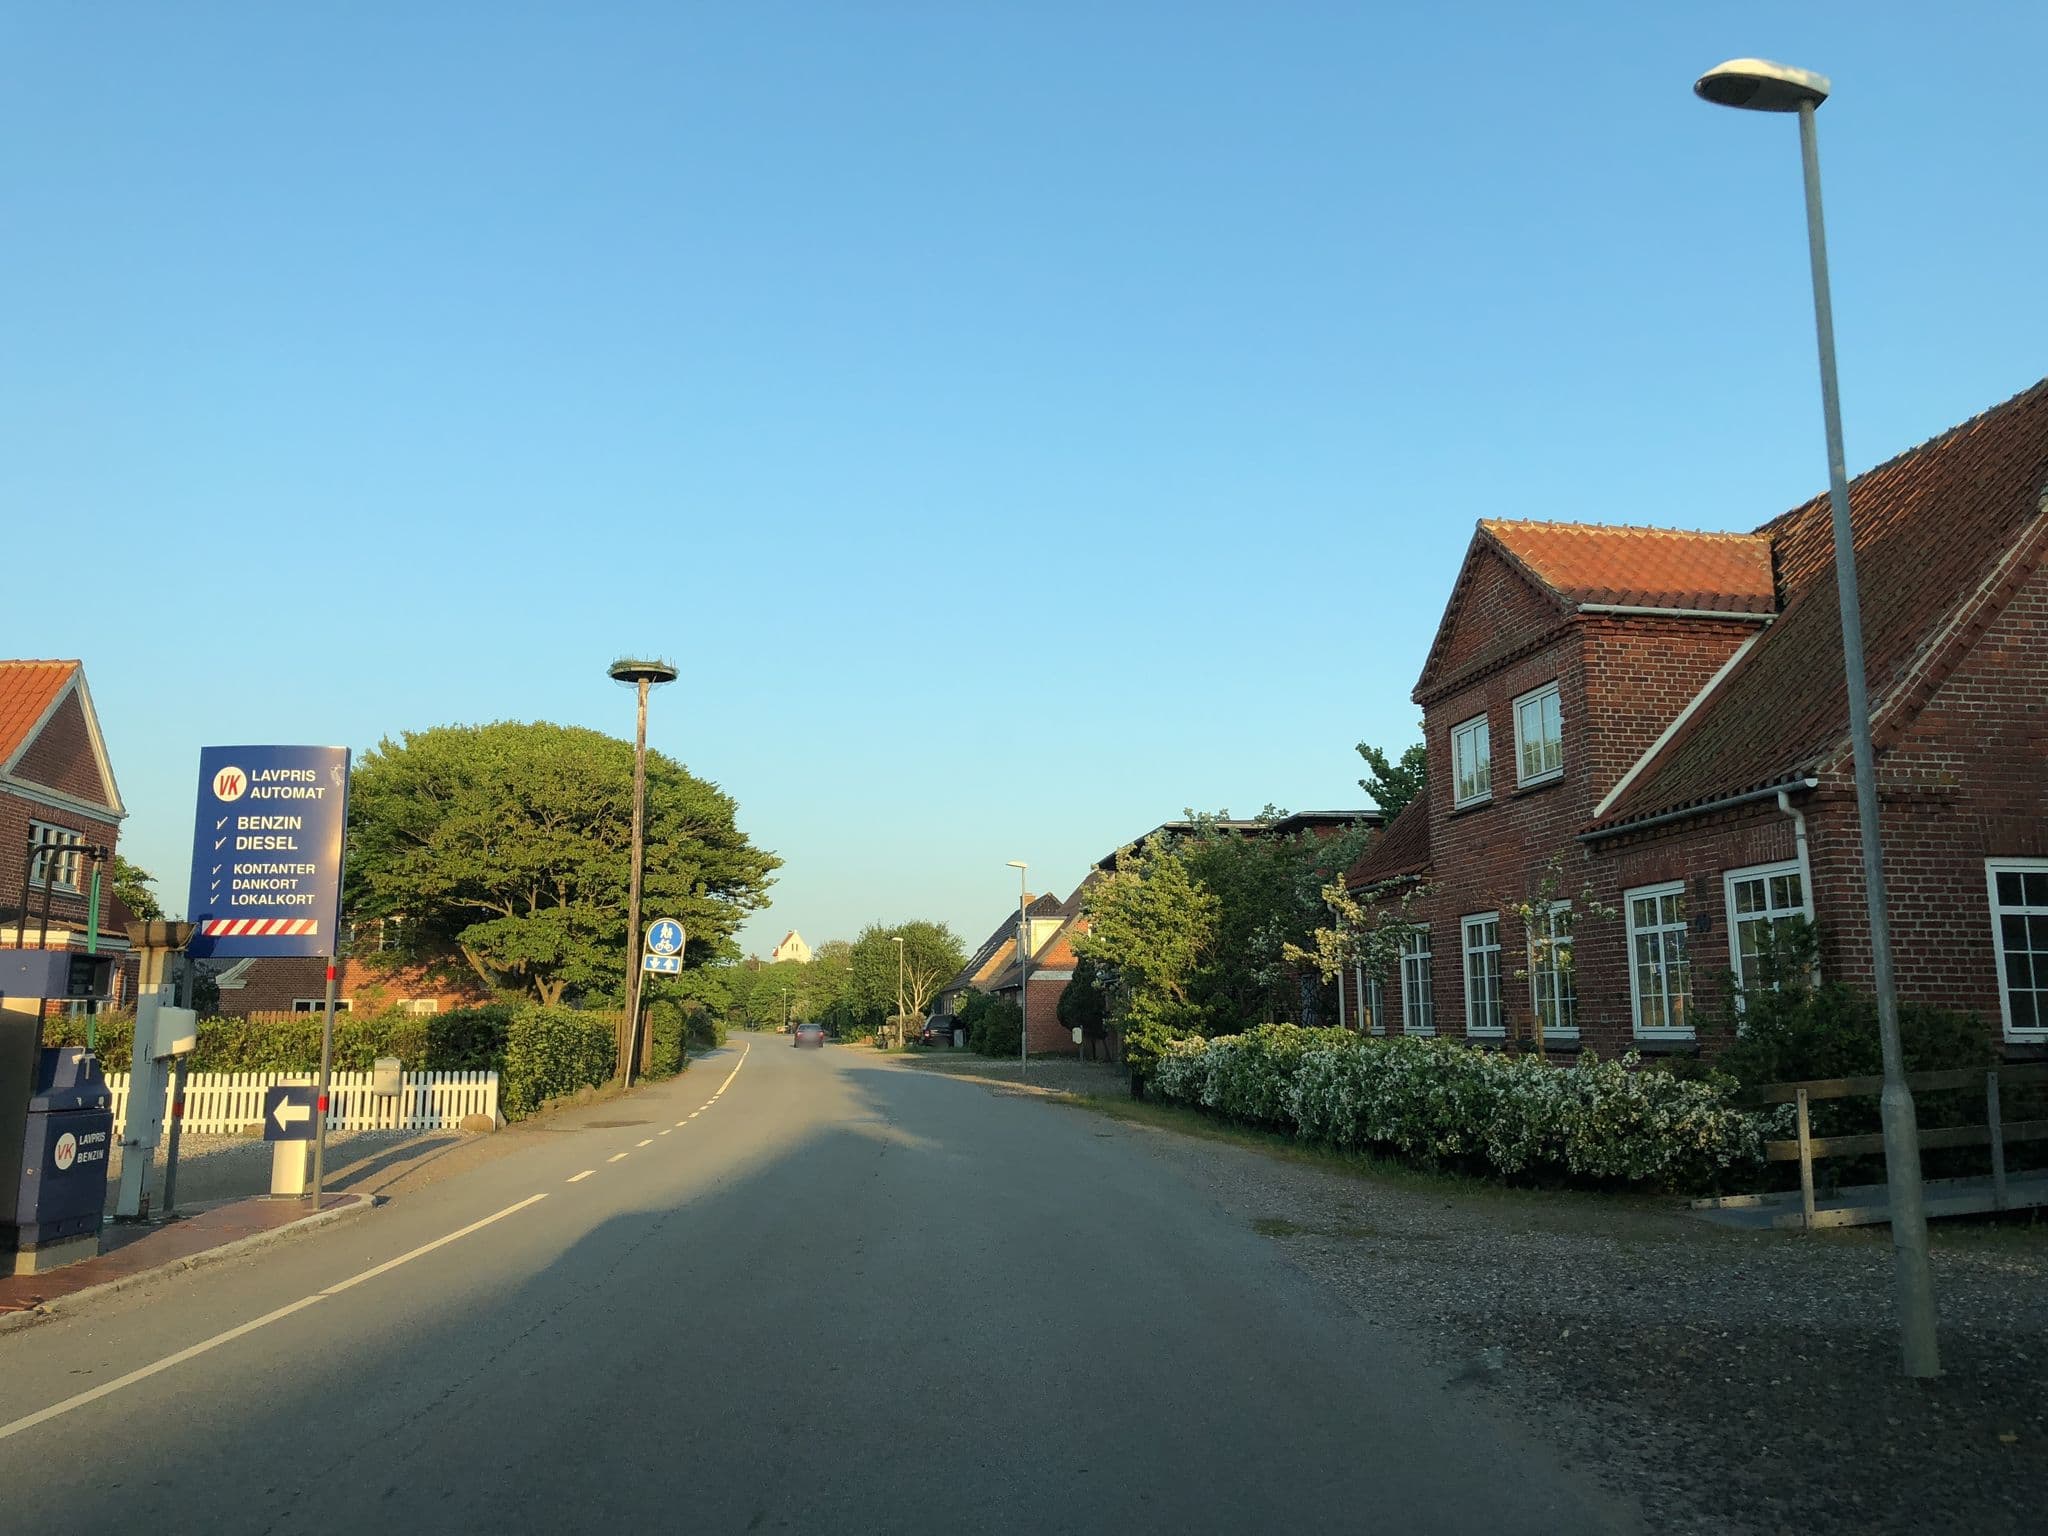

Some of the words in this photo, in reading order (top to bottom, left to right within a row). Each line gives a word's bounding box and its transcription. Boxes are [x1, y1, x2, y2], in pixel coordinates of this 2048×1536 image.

[252, 770, 316, 782] LAVPRIS
[219, 774, 241, 796] VK
[250, 787, 325, 799] AUTOMAT
[237, 816, 302, 830] BENZIN
[236, 836, 298, 850] DIESEL
[233, 863, 315, 875] KONTANTER
[232, 879, 298, 890] DANKORT
[231, 894, 315, 906] LOKALKORT
[79, 1131, 106, 1146] LAVPRIS
[57, 1143, 74, 1161] VK
[77, 1149, 104, 1164] BENZIN
